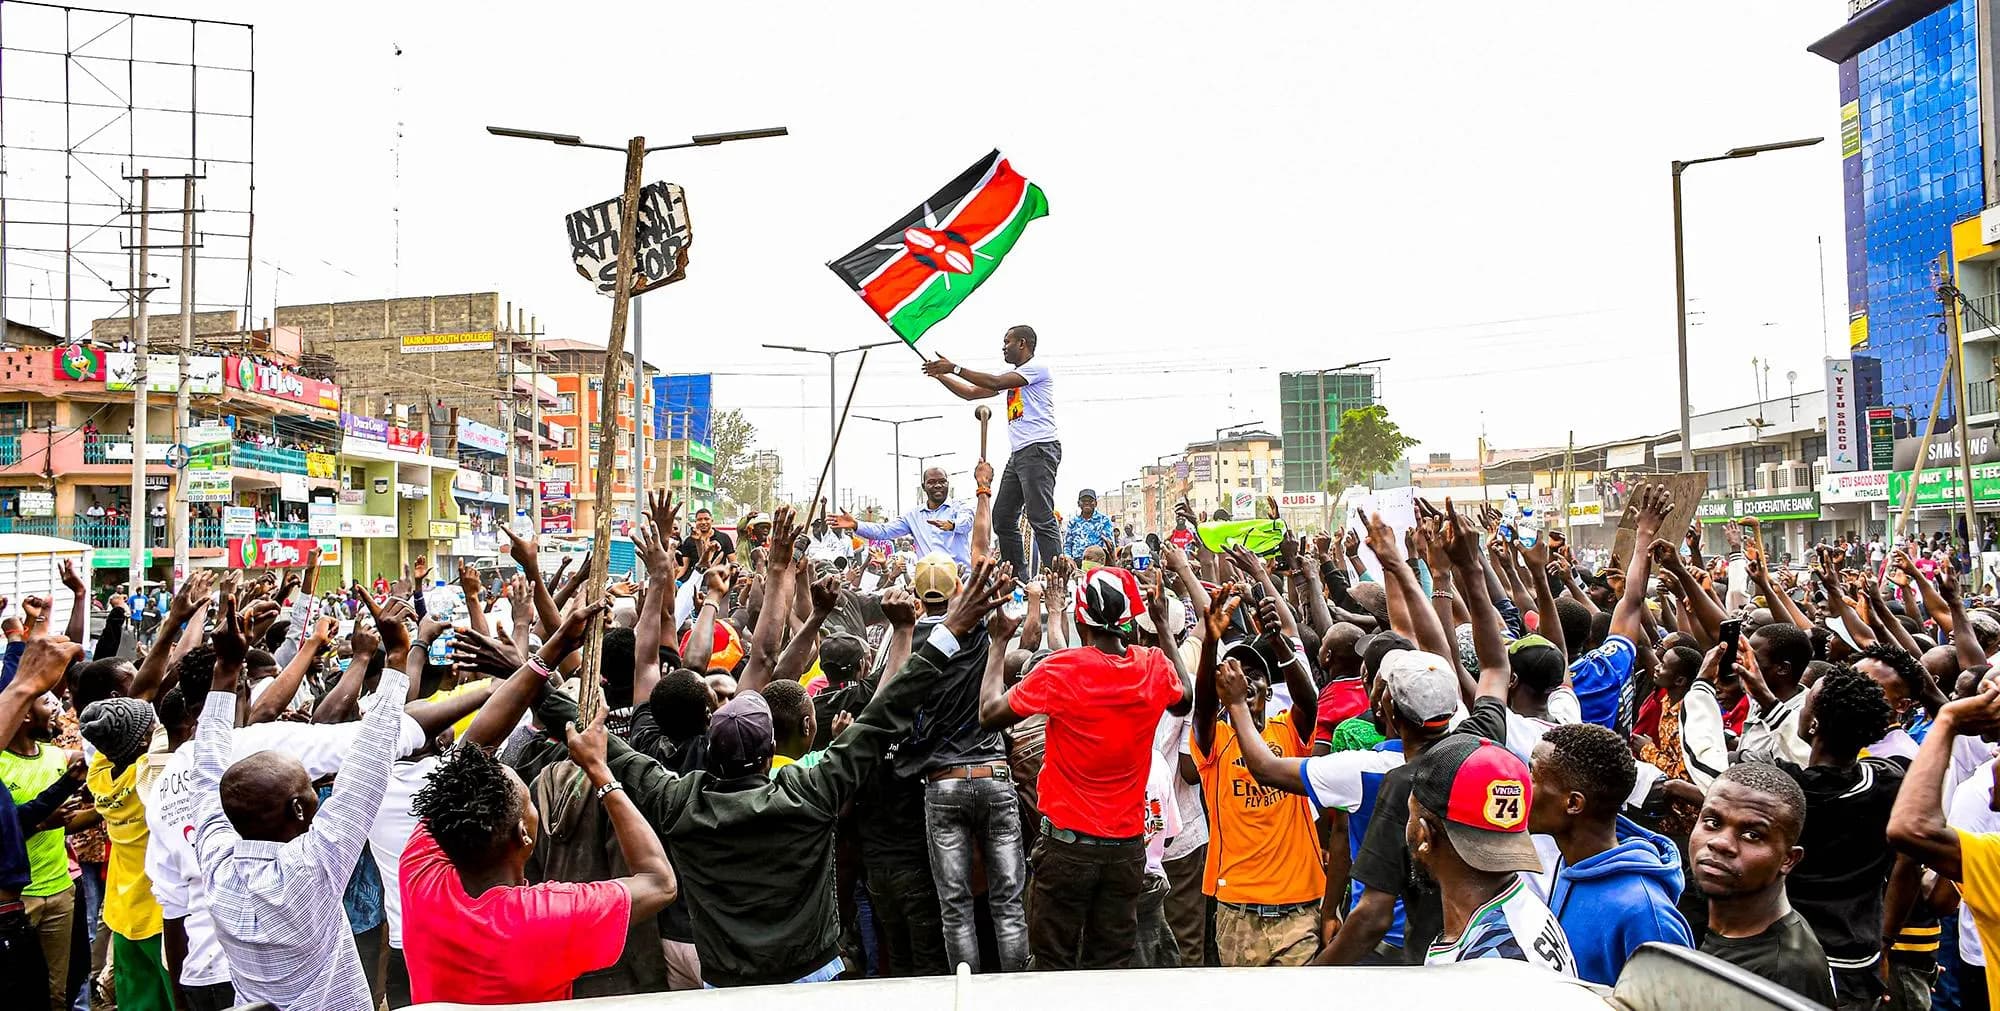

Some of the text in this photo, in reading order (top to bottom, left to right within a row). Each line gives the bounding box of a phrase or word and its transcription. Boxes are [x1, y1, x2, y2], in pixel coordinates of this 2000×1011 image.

[403, 332, 493, 346] NAIROBI SOUTH COLLEGE
[1835, 377, 1847, 451] YETU SACCO
[1928, 437, 1988, 461] SAMSNG
[146, 476, 168, 485] ENTAL
[1710, 503, 1728, 516] BANK
[1744, 497, 1814, 513] CO-OPERATIVE BANK
[1495, 787, 1521, 795] VINTAGE
[1245, 796, 1262, 808] FLY
[1495, 798, 1519, 819] 74
